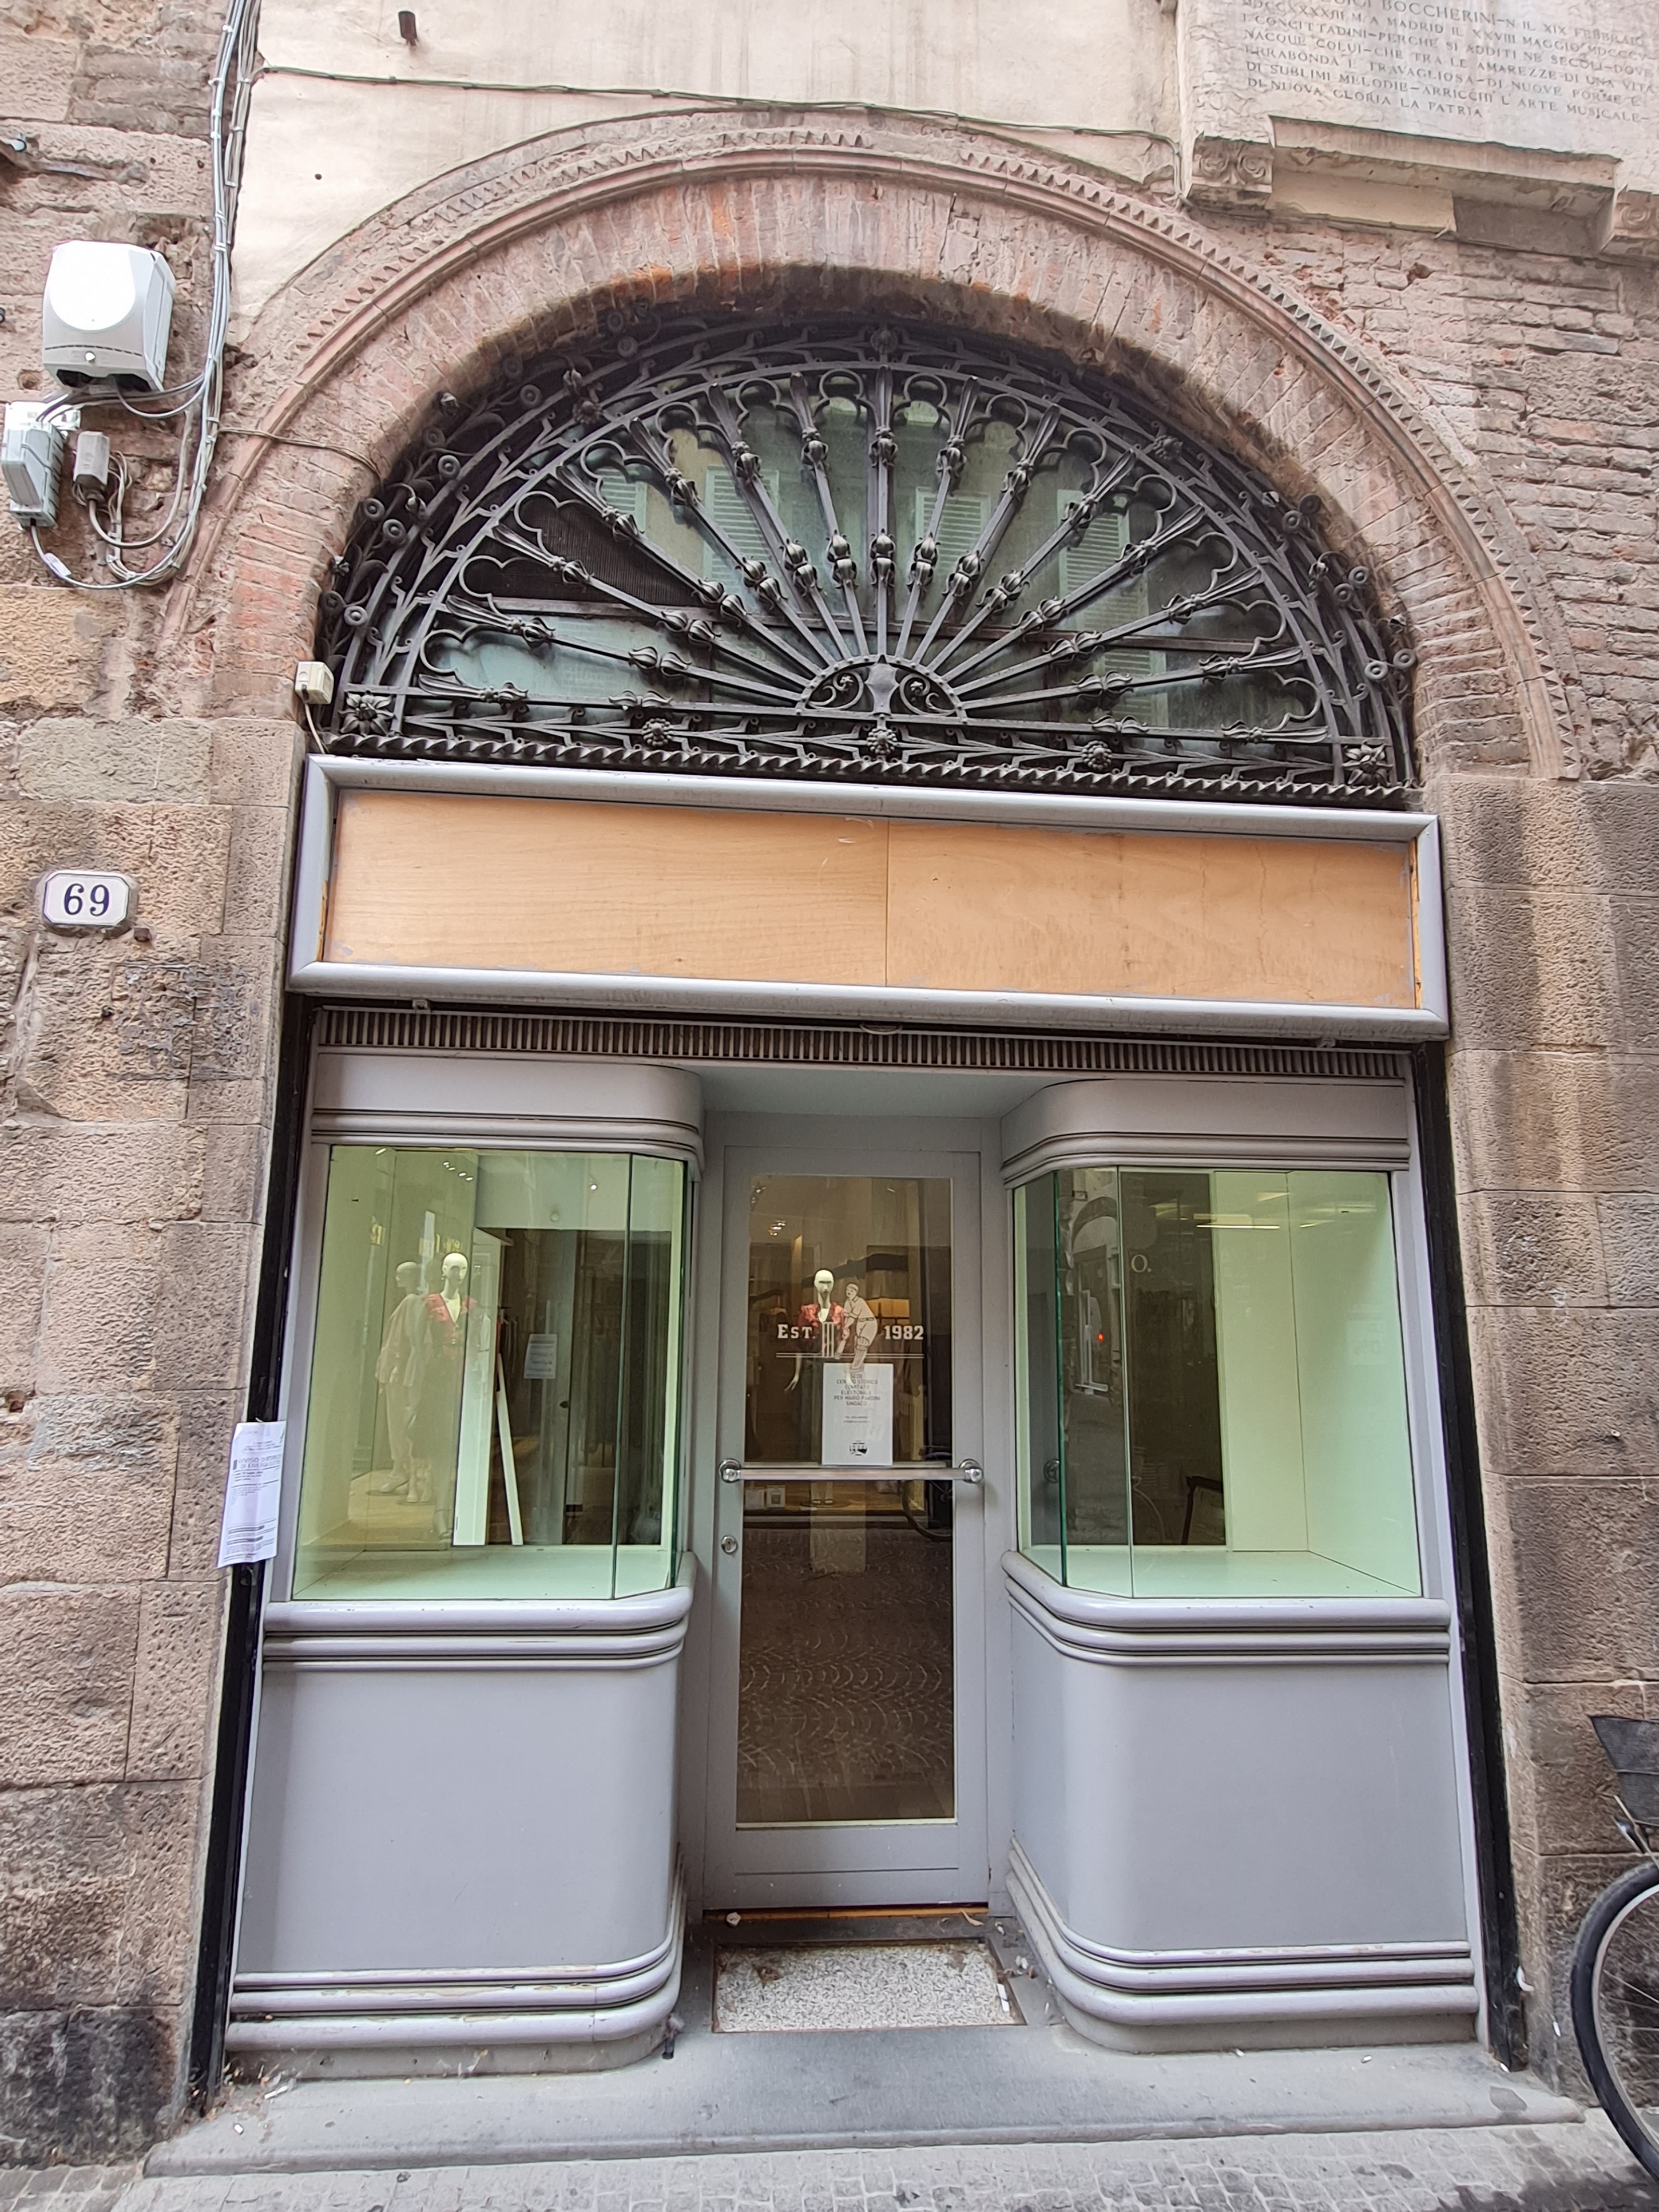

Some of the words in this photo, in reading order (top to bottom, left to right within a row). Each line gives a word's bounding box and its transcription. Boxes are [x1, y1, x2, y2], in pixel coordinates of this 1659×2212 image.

[1370, 15, 1379, 25] A
[1387, 17, 1444, 34] MADRID
[1452, 27, 1464, 36] IL
[1473, 29, 1515, 44] XXVIII
[1522, 36, 1580, 52] MAGGIO
[1543, 23, 1566, 35] XIX
[1446, 42, 1458, 51] SI
[1466, 45, 1516, 60] ADDITI
[1244, 29, 1307, 46] NACQUE
[1412, 52, 1442, 65] TRA
[1450, 58, 1468, 68] LE
[1622, 80, 1655, 94] VITA
[1247, 61, 1261, 72] DI
[1270, 64, 1331, 81] SUBLIMI
[1511, 81, 1562, 96] NUOVE
[1271, 80, 1323, 97] NUOVA
[1332, 89, 1392, 105] GLORIA
[1400, 98, 1420, 109] LA
[1428, 101, 1483, 118] PATRIA
[64, 883, 110, 917] 69
[884, 1325, 924, 1340] 1982
